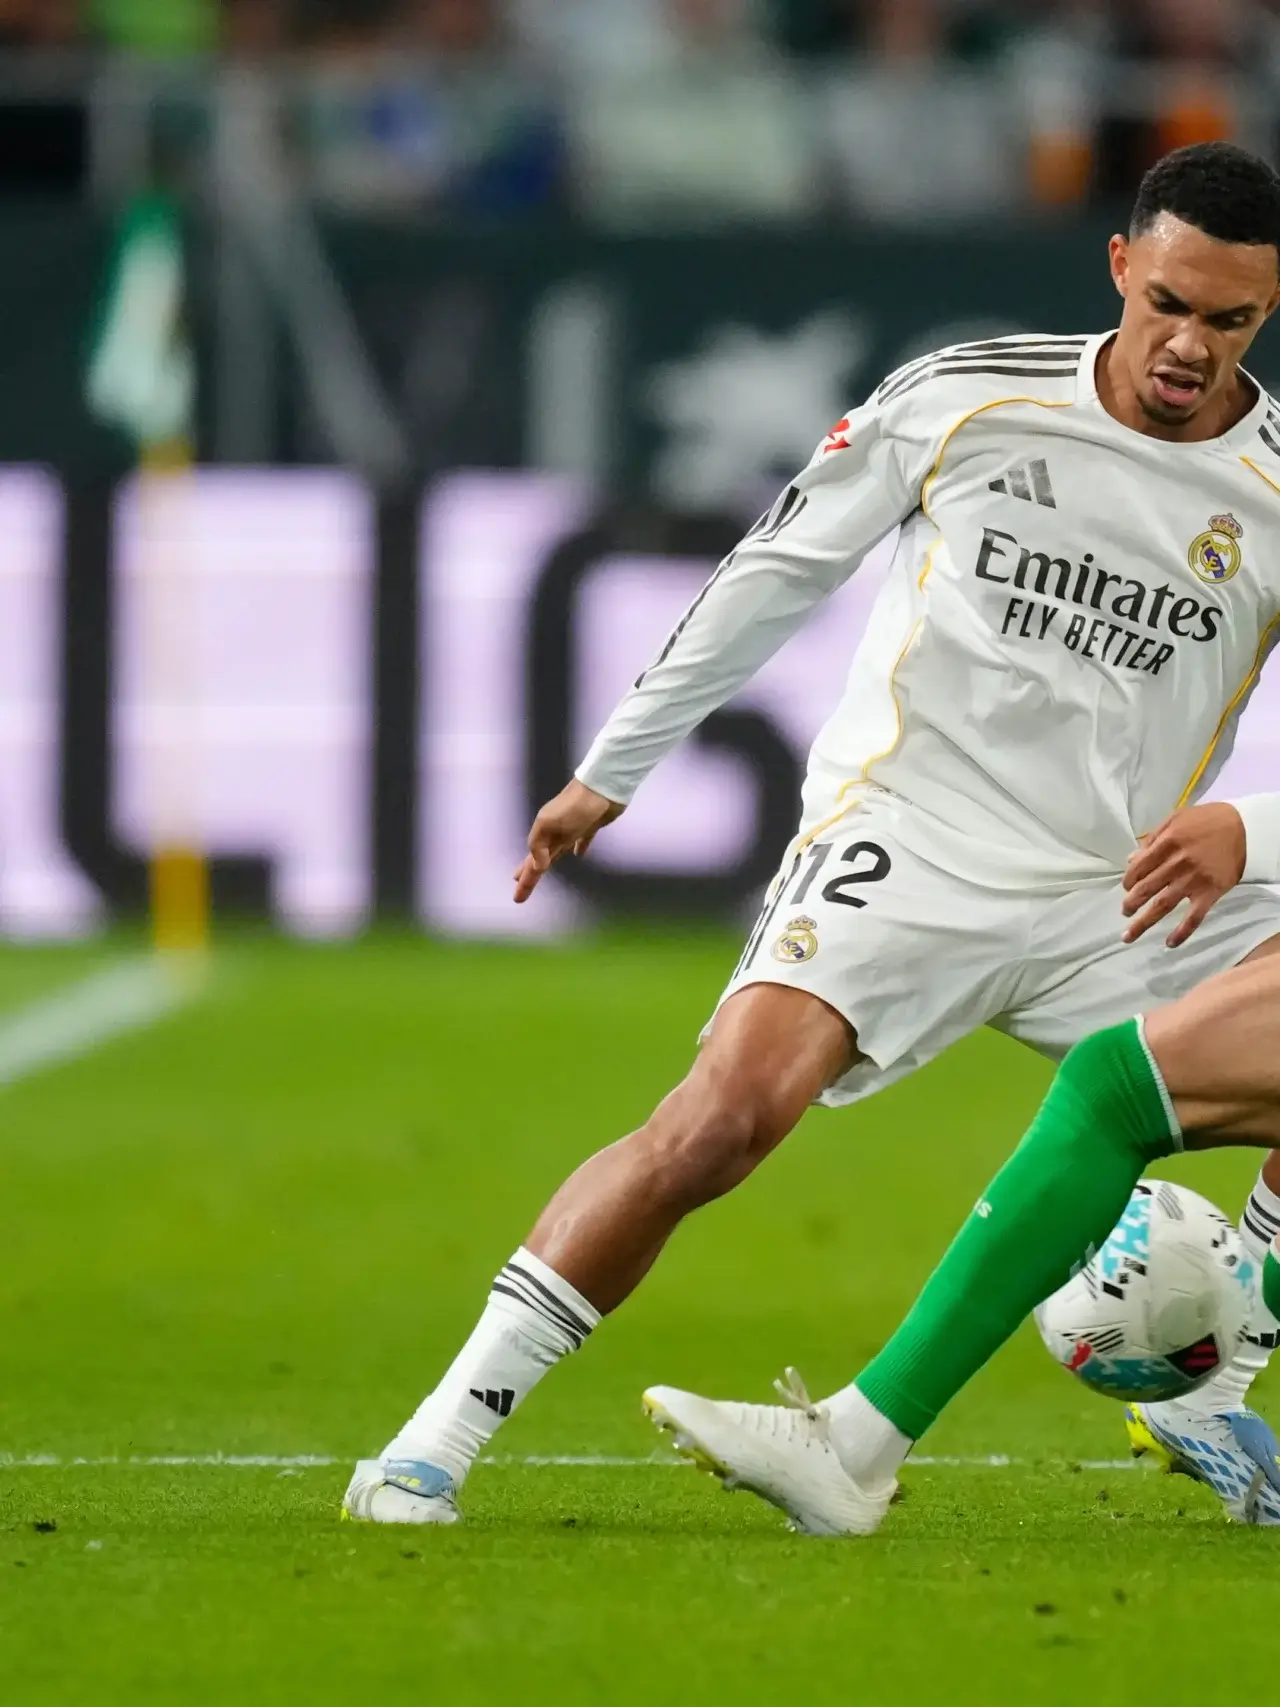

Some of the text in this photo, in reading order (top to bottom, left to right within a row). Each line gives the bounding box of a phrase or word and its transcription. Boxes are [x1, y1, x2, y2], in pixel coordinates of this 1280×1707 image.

[975, 526, 1223, 642] Emirates
[1001, 597, 1175, 676] FLY BETTER
[789, 841, 892, 909] 12
